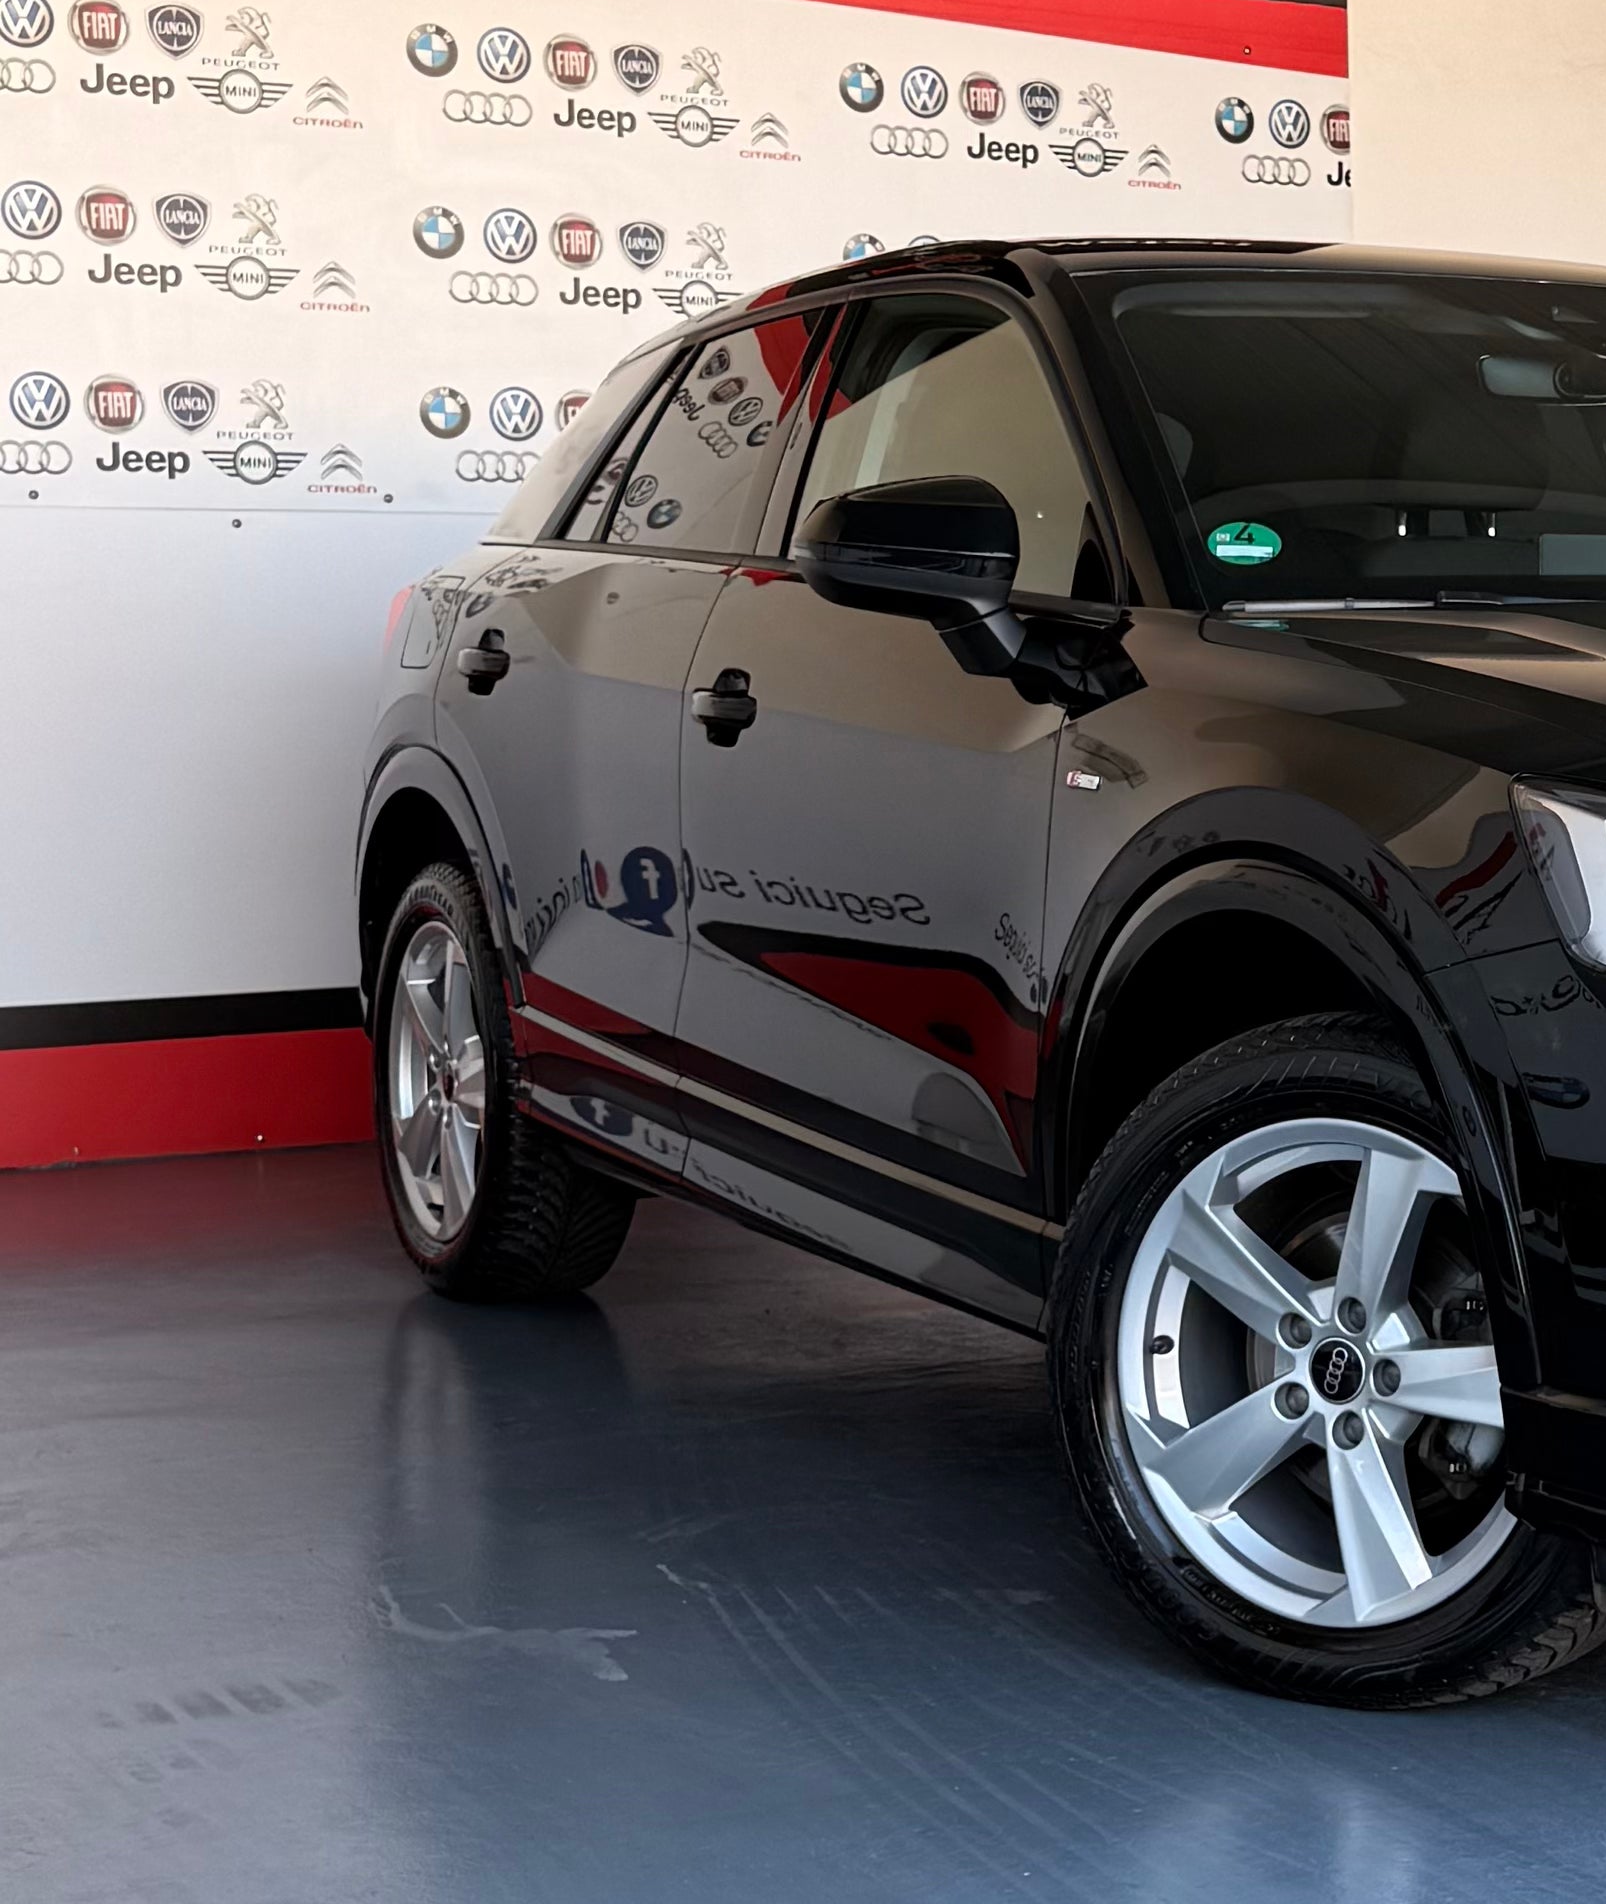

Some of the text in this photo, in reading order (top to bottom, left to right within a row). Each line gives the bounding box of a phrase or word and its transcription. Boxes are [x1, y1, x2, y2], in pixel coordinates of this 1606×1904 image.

[82, 11, 118, 41] FIAT
[157, 20, 194, 37] LANCIA
[201, 57, 281, 71] PEUGEOT
[555, 49, 588, 79] FIAT
[622, 58, 652, 74] LANCIA
[80, 63, 176, 105] Jeep
[225, 84, 257, 99] MINI
[660, 94, 729, 107] PEUGEOT
[969, 85, 997, 113] FIAT
[553, 98, 637, 138] Jeep
[681, 119, 709, 132] MINI
[1059, 127, 1119, 139] PEUGEOT
[967, 132, 1039, 169] Jeep
[1077, 152, 1102, 164] MINI
[90, 202, 126, 230] FIAT
[165, 209, 200, 225] LANCIA
[562, 228, 593, 256] FIAT
[208, 245, 288, 257] PEUGEOT
[88, 253, 182, 293] Jeep
[232, 272, 264, 286] MINI
[664, 269, 734, 281] PEUGEOT
[559, 277, 642, 315] Jeep
[685, 294, 714, 307] MINI
[99, 391, 133, 419] FIAT
[173, 396, 208, 412] LANCIA
[217, 431, 295, 441] PEUGEOT
[96, 442, 190, 479] Jeep
[240, 457, 272, 470] MINI
[1233, 523, 1255, 545] 4
